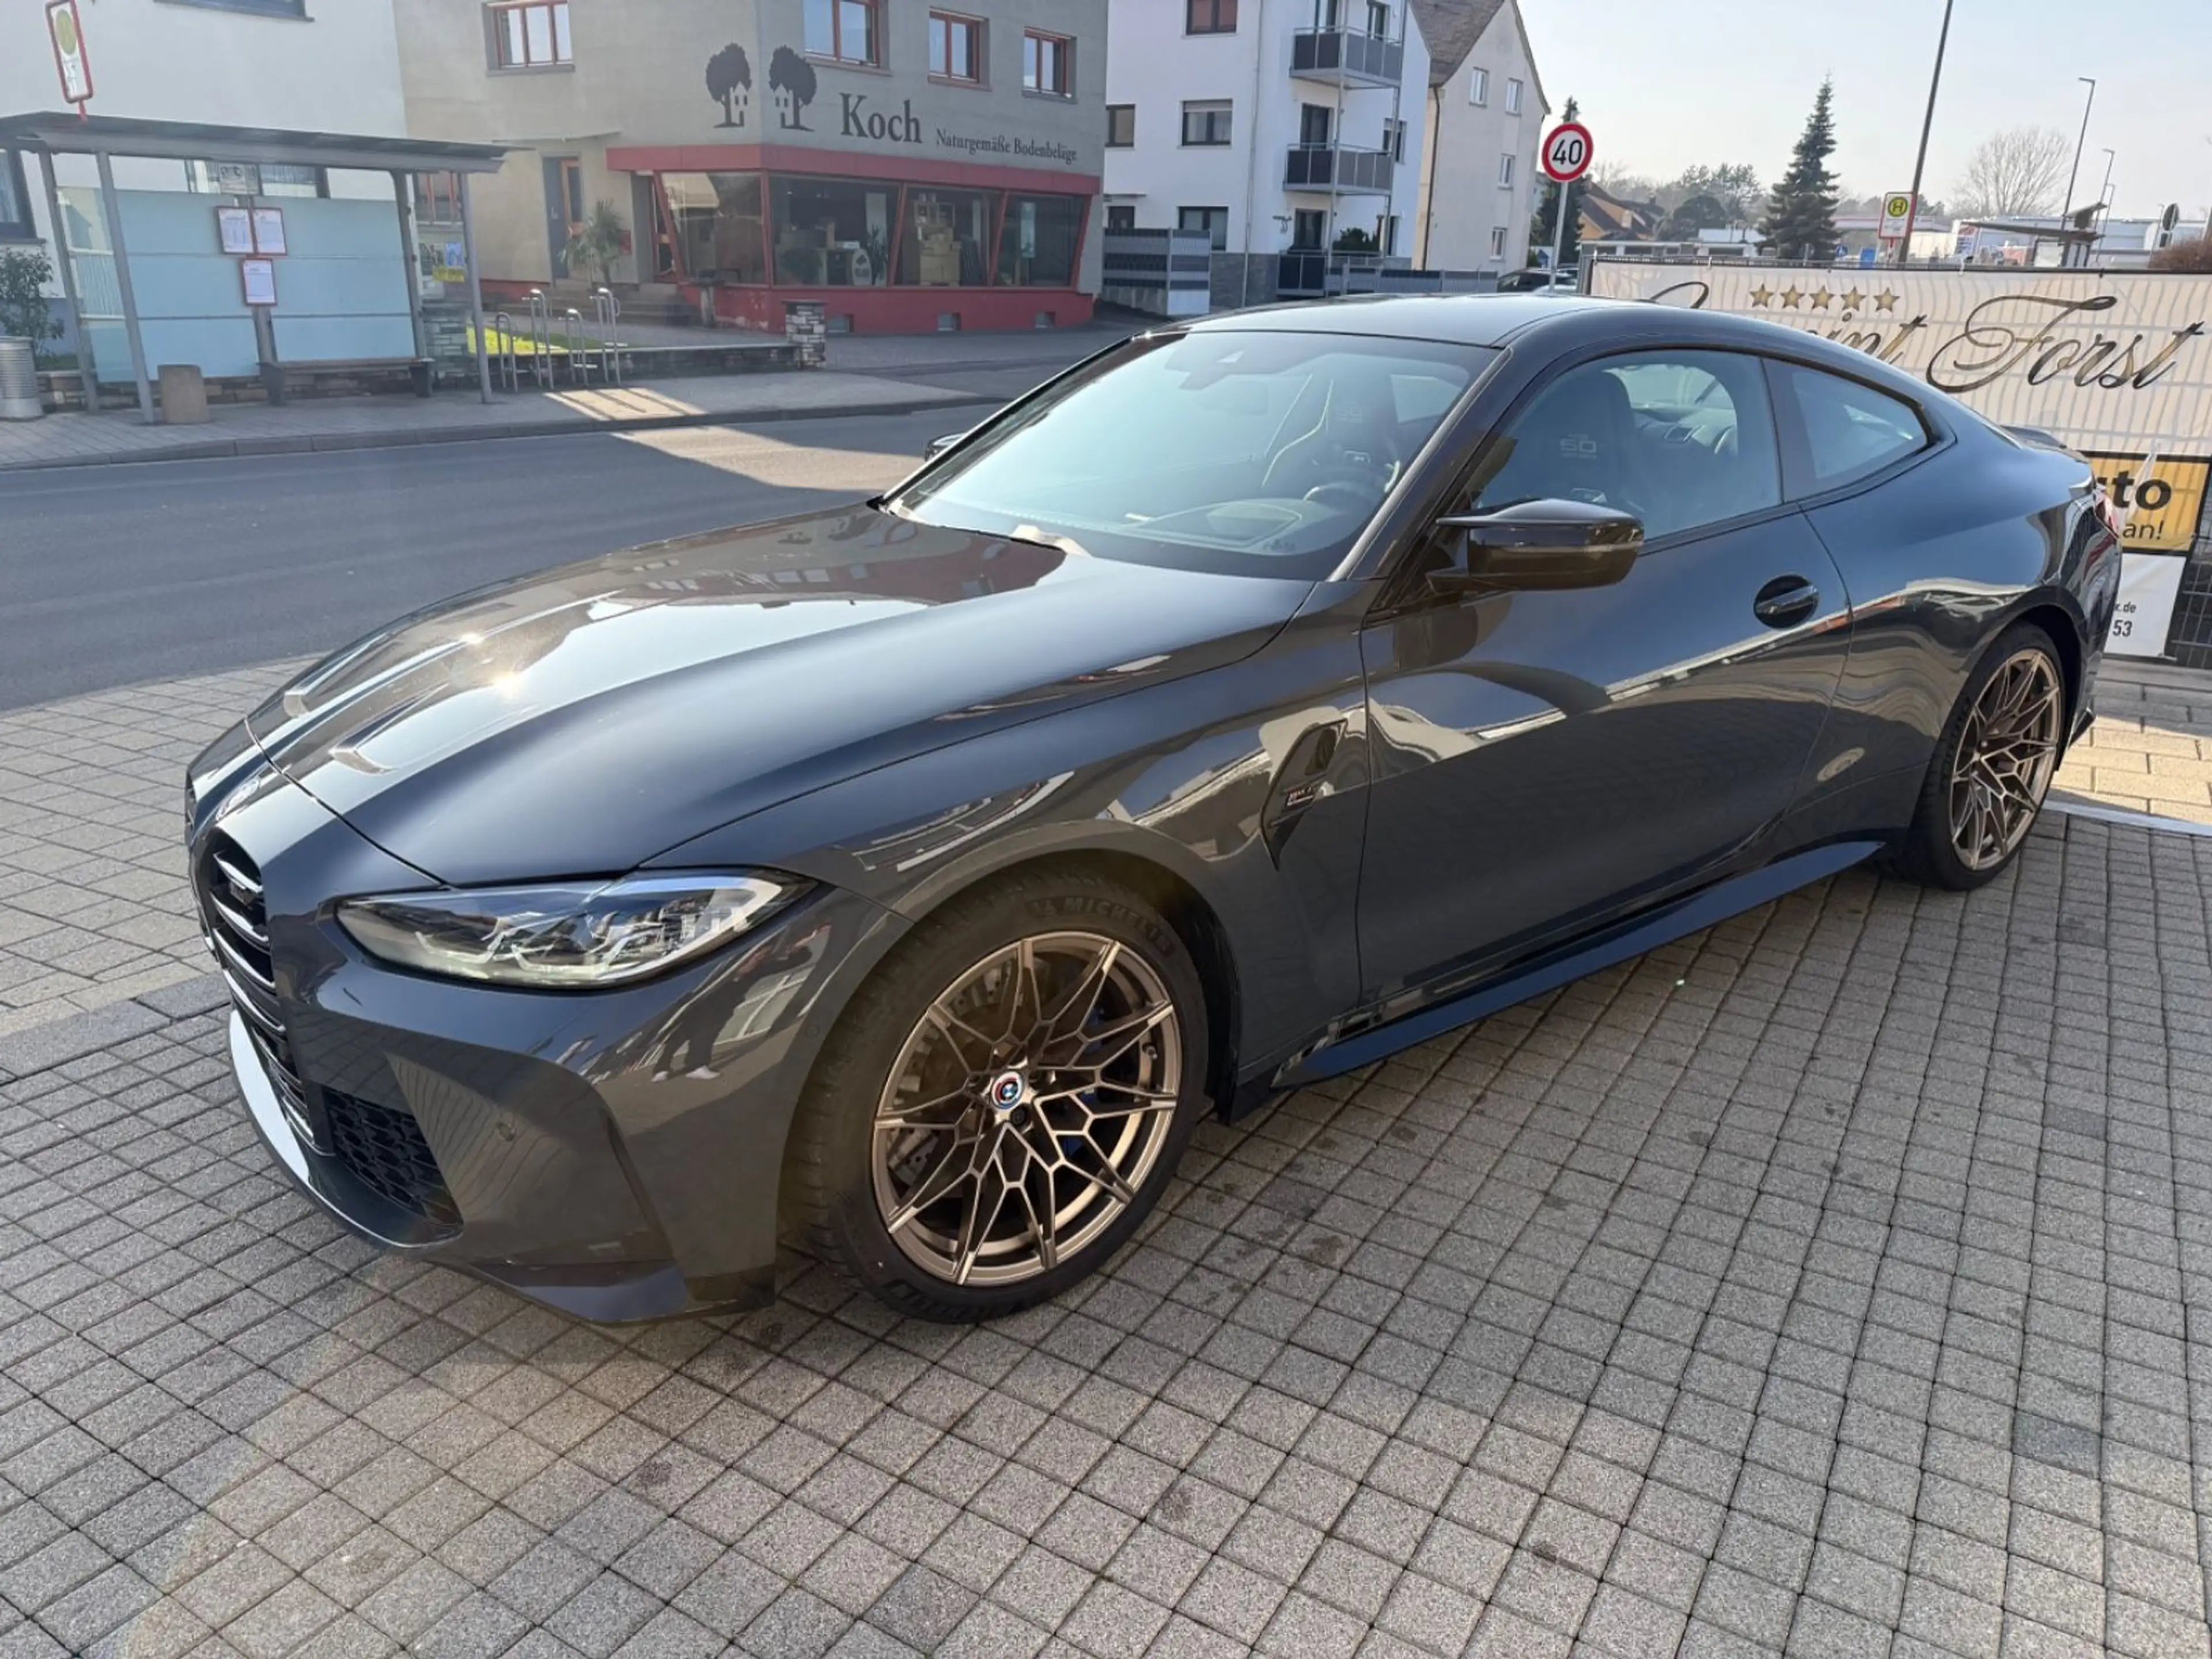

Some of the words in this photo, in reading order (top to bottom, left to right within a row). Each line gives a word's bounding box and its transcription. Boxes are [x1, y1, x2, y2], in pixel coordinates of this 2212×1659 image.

[839, 92, 922, 143] Koch
[937, 128, 1011, 155] Naturgemäße
[1014, 138, 1077, 165] Bodenbeläge
[1552, 139, 1582, 165] 40
[1926, 296, 2205, 393] Forst
[2097, 471, 2172, 510] to
[2122, 520, 2164, 540] an!
[2112, 619, 2133, 637] 53
